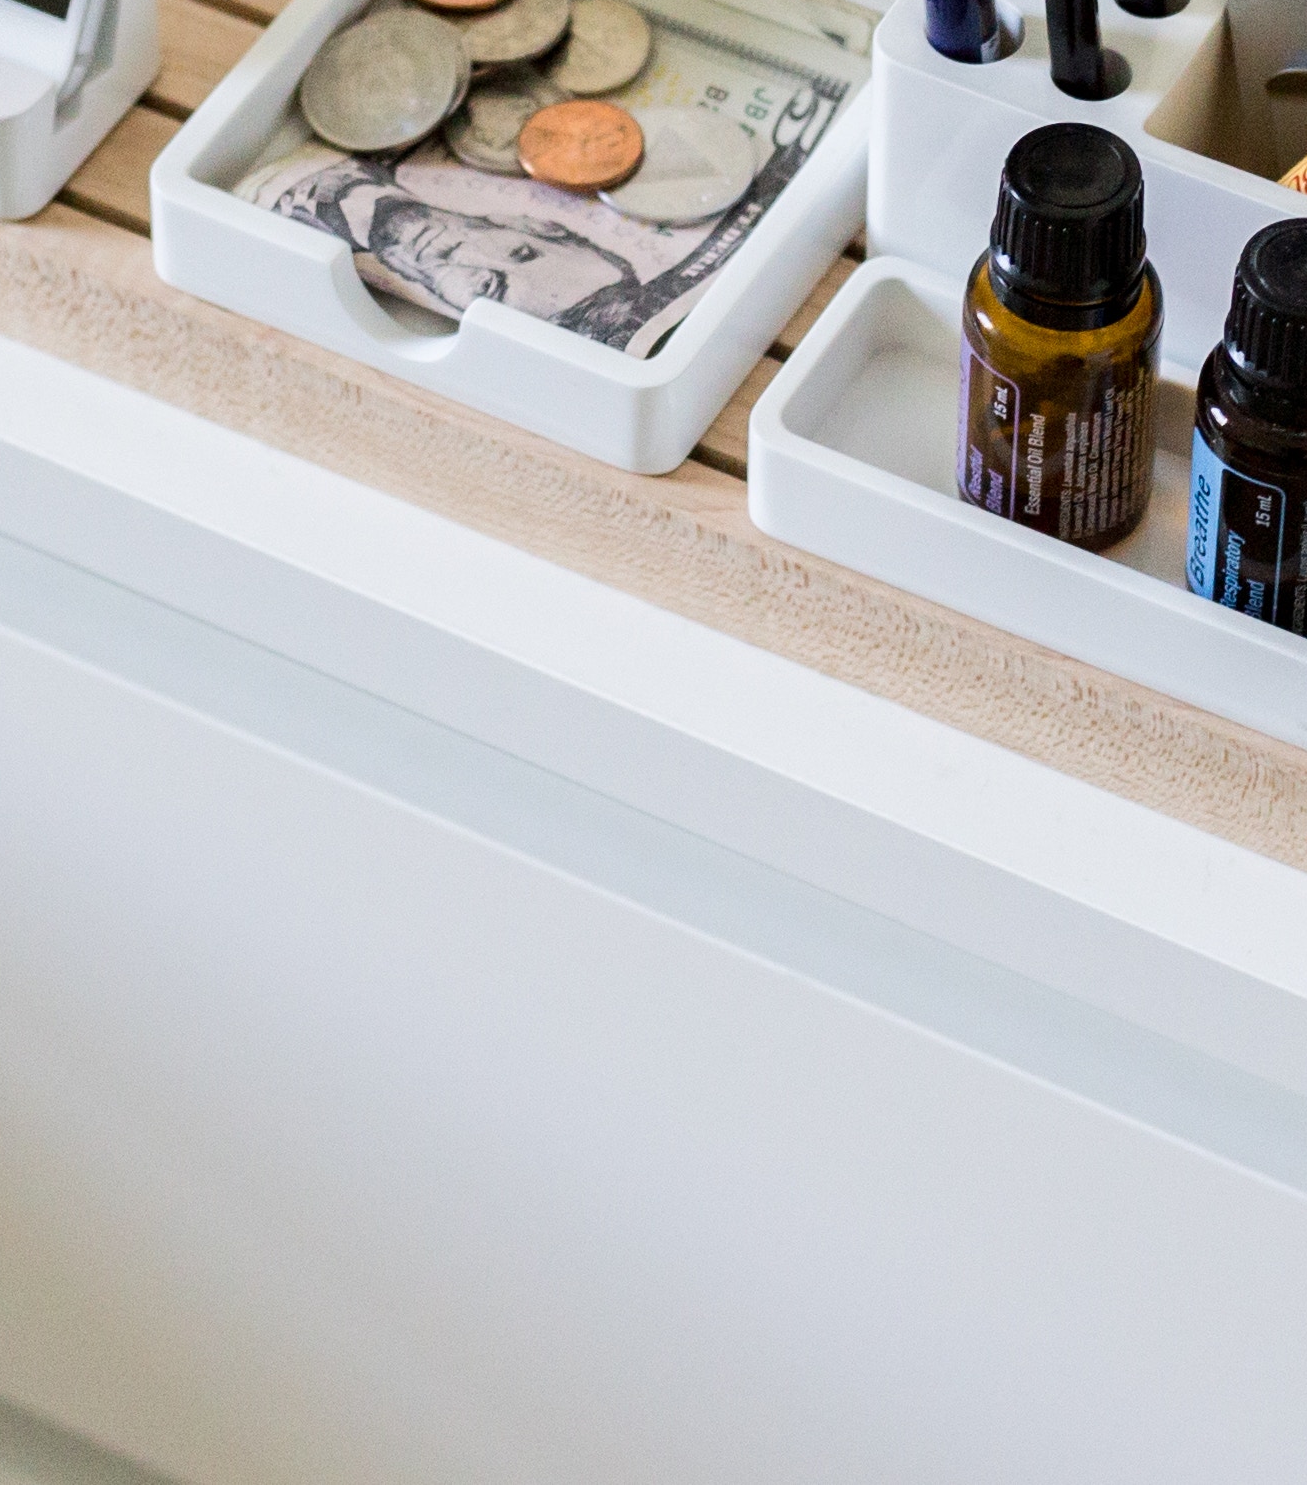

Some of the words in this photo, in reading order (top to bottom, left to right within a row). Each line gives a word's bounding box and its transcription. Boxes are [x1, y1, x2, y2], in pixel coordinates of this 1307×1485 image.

[993, 402, 1008, 420] 15
[1028, 413, 1046, 447] Blend
[1027, 448, 1044, 465] Oil
[1024, 464, 1043, 516] Essential
[1190, 474, 1211, 588] Breathe
[1255, 512, 1271, 528] 15
[1220, 529, 1246, 609] Respiratory
